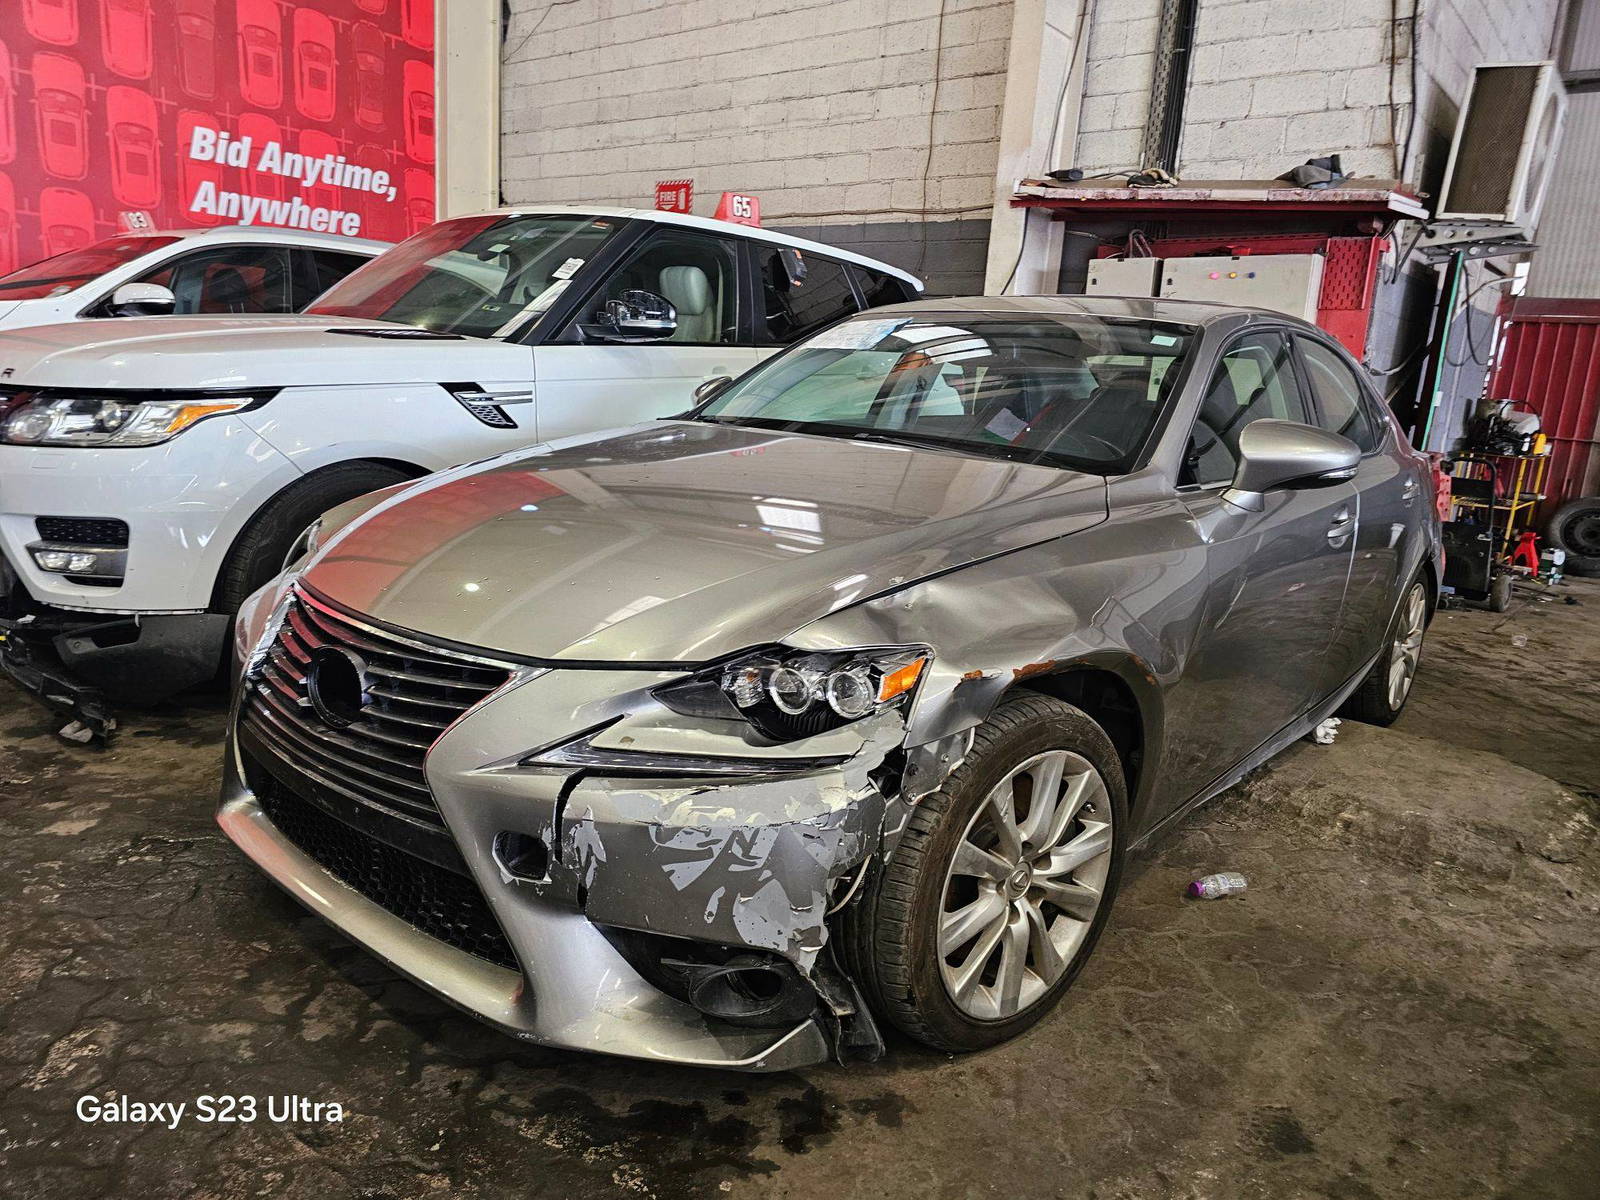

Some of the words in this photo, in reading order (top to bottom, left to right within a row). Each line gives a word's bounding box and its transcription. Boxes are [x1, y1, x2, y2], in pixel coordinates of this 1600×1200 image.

[189, 126, 252, 168] Bid
[256, 141, 397, 202] Anytime,
[190, 180, 361, 236] Anywhere
[660, 191, 677, 202] FIRE
[732, 195, 752, 218] 65
